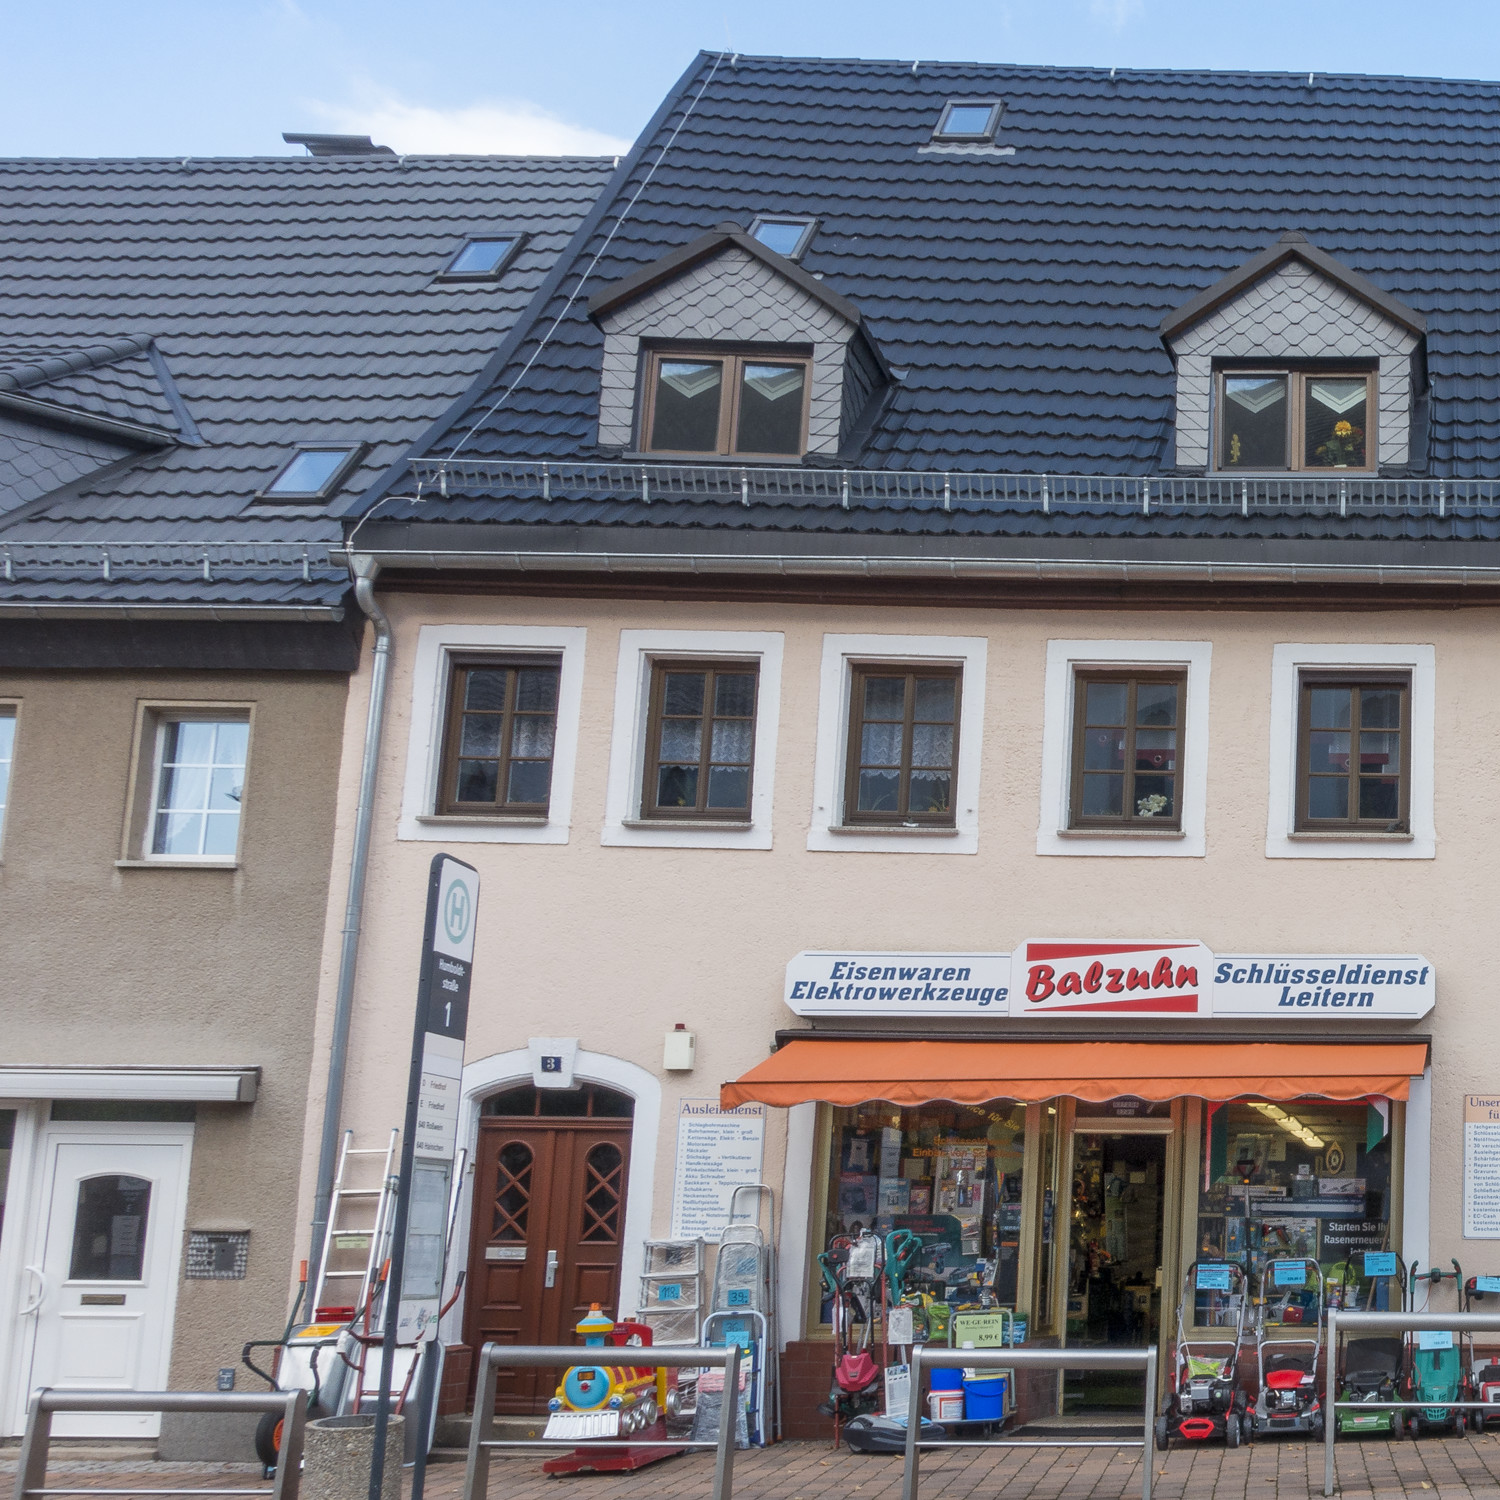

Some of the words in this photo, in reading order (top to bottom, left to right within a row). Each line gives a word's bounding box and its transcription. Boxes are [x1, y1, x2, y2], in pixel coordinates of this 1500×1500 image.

[829, 961, 971, 981] Eisenwaren
[1024, 956, 1199, 1003] Balzuhn
[1214, 962, 1429, 985] Schlüsseldienst
[789, 981, 1009, 1006] Elektrowerkzeuge
[1278, 986, 1374, 1008] Leitern
[444, 1001, 451, 1028] 1
[546, 1057, 556, 1071] 3
[1470, 1097, 1500, 1107] Unser
[1328, 1222, 1361, 1232] Starten
[1362, 1222, 1376, 1232] Sie
